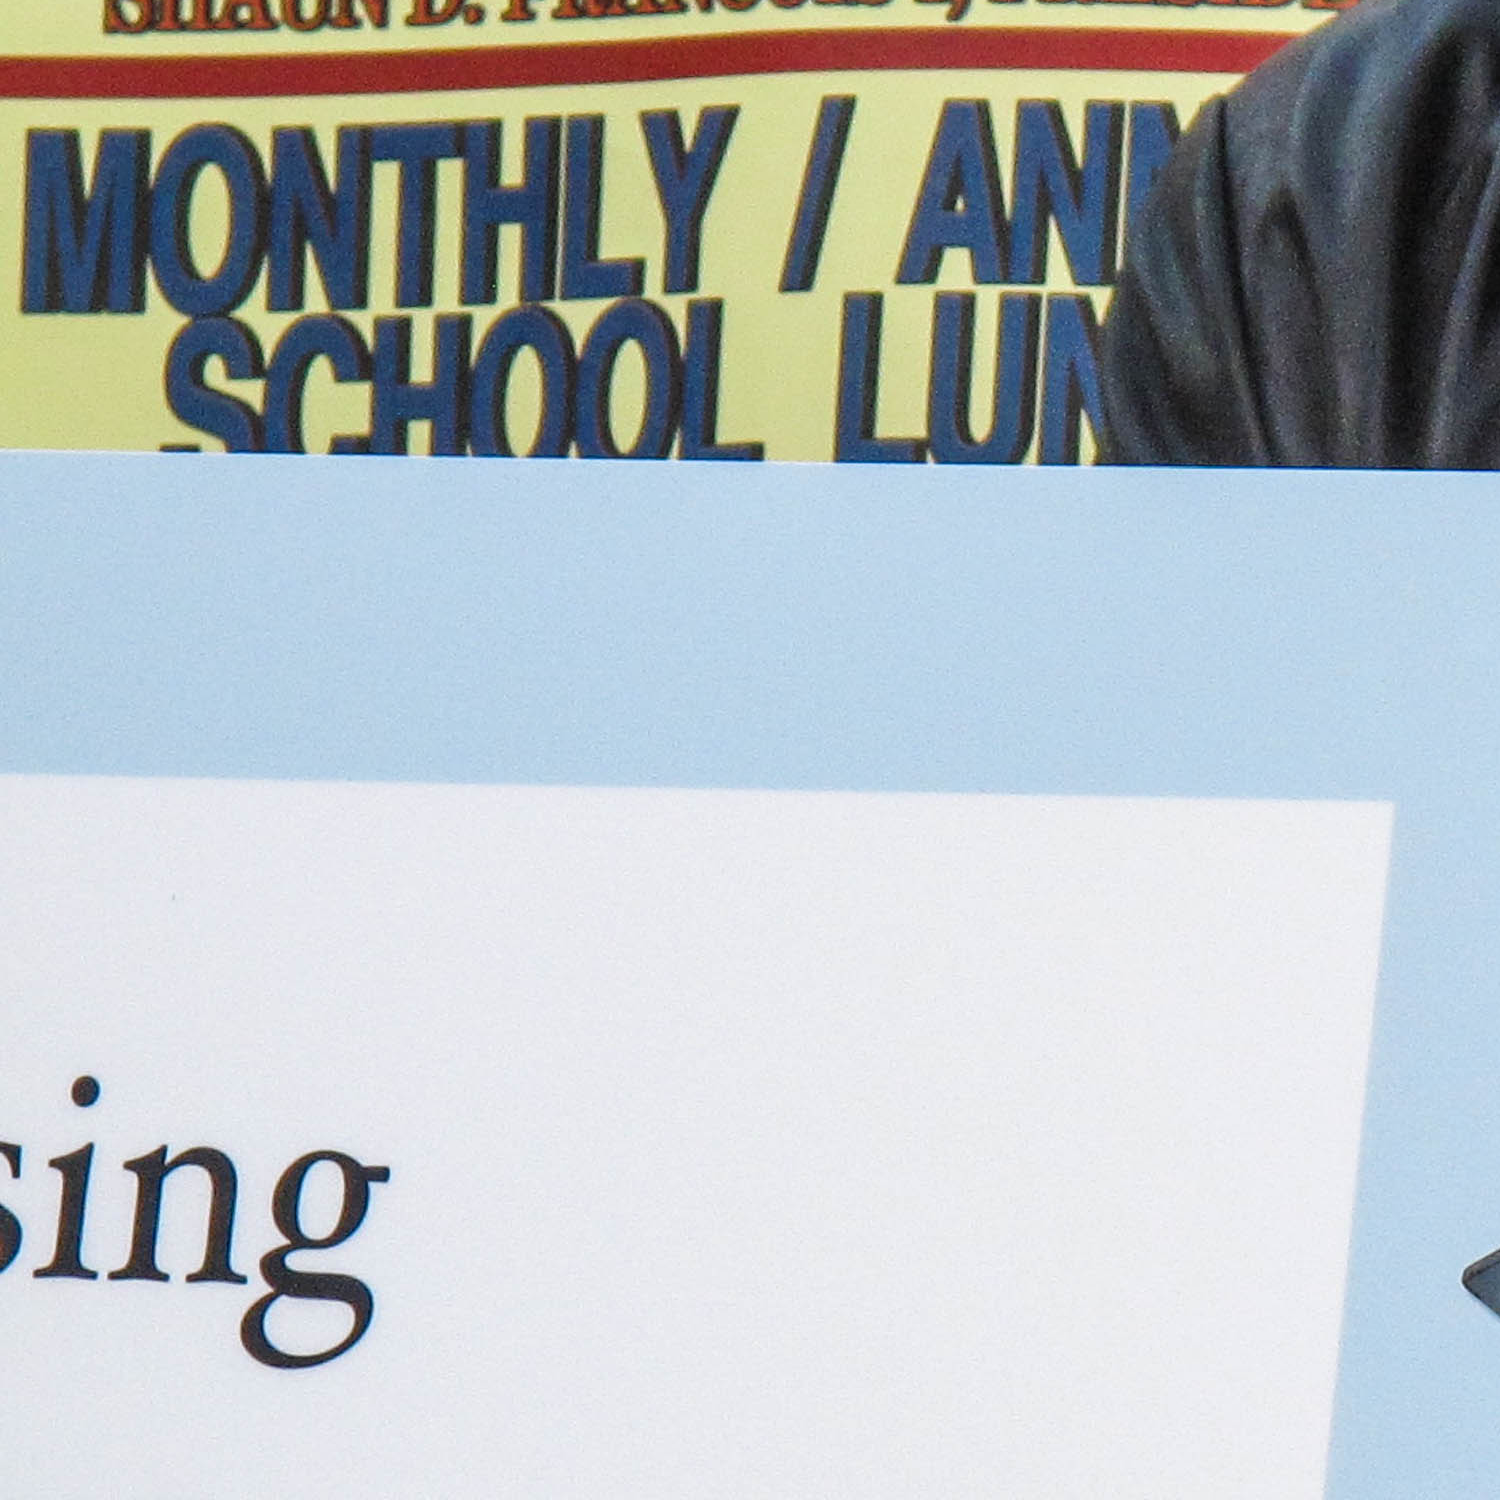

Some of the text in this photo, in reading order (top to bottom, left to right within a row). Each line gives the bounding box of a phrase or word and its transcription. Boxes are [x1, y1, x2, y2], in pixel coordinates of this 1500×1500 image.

[20, 103, 742, 315] MONTHLY
[778, 94, 857, 294] /
[160, 295, 766, 463] SCHOOL
